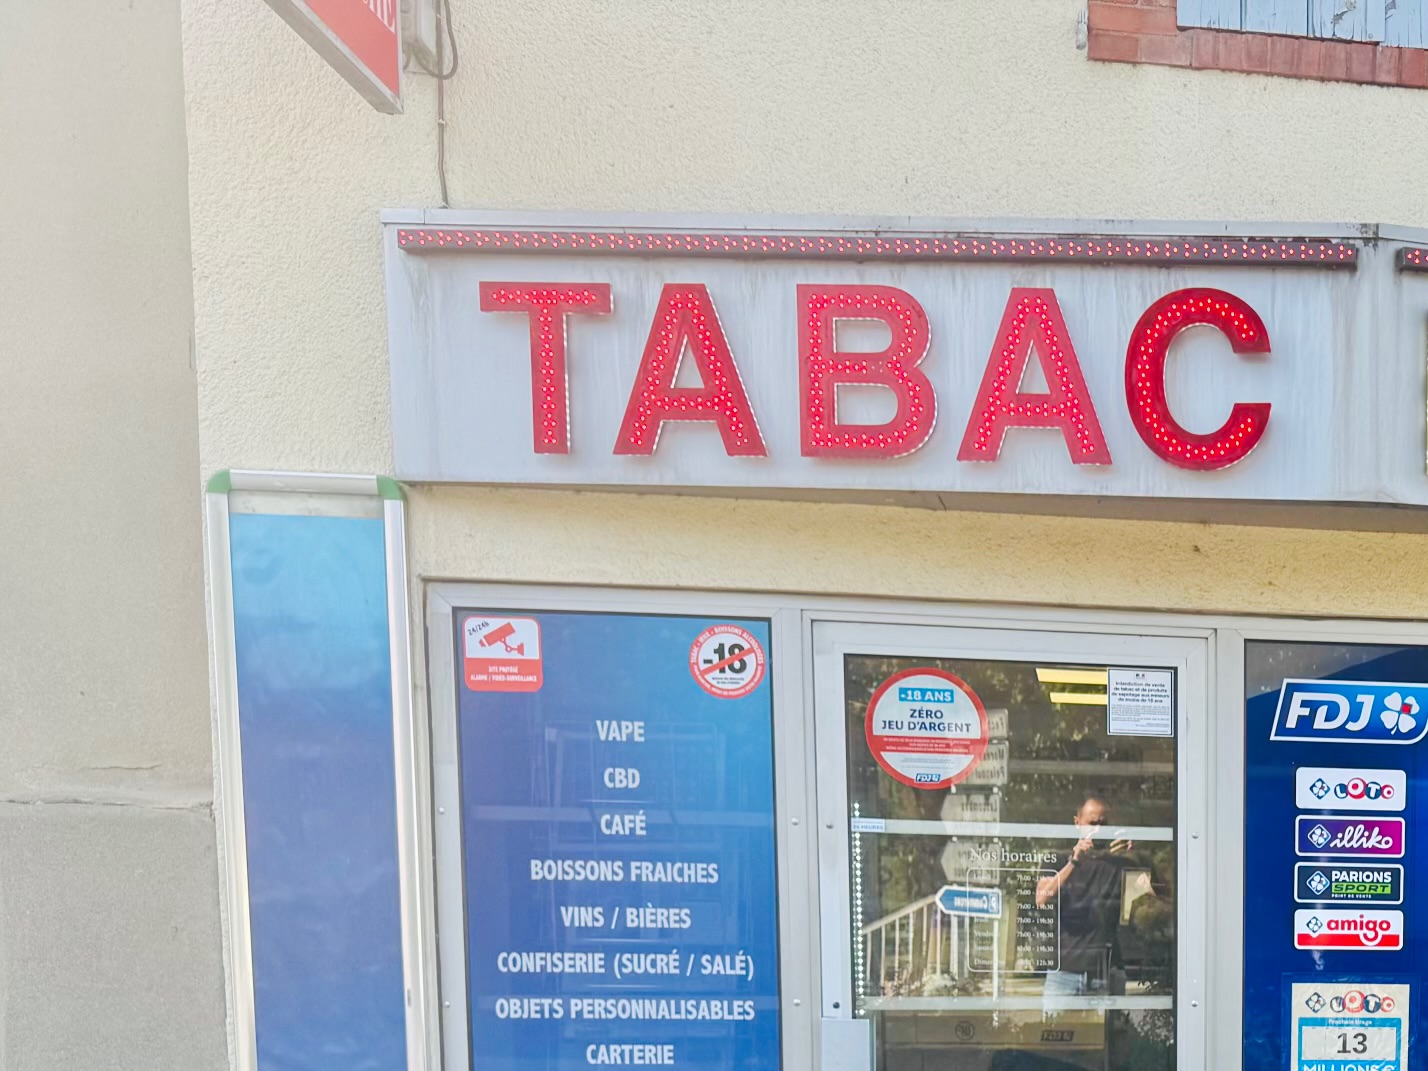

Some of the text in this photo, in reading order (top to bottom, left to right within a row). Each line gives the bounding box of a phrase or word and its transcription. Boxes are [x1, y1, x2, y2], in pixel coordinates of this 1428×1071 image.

[479, 281, 1271, 470] TABAC
[703, 643, 747, 674] -18
[901, 690, 951, 702] -18 ANS
[909, 706, 943, 719] ZÉRO
[1285, 691, 1375, 731] FDJ
[596, 720, 645, 742] VAPE
[882, 720, 971, 732] JEU D'ARGENT
[603, 767, 641, 789] CBD
[1334, 777, 1395, 800] LOTO
[600, 810, 647, 836] CAFÉ
[1330, 824, 1393, 849] illiko
[970, 847, 1057, 863] Nos horaires
[530, 860, 719, 883] BOISSONS FRAICHES
[1331, 870, 1392, 883] PARIONS
[1333, 884, 1390, 893] SPORT
[560, 906, 605, 928] VINS
[626, 902, 692, 929] BIÈRES
[1326, 914, 1391, 946] amigo
[497, 952, 605, 973] CONFISERIE
[613, 949, 680, 979] (SUCRÉ
[701, 950, 755, 981] SALÉ)
[495, 999, 755, 1021] OBJETS PERSONNALISABLES
[1336, 1032, 1368, 1054] 13
[586, 1044, 675, 1065] CARTERIE
